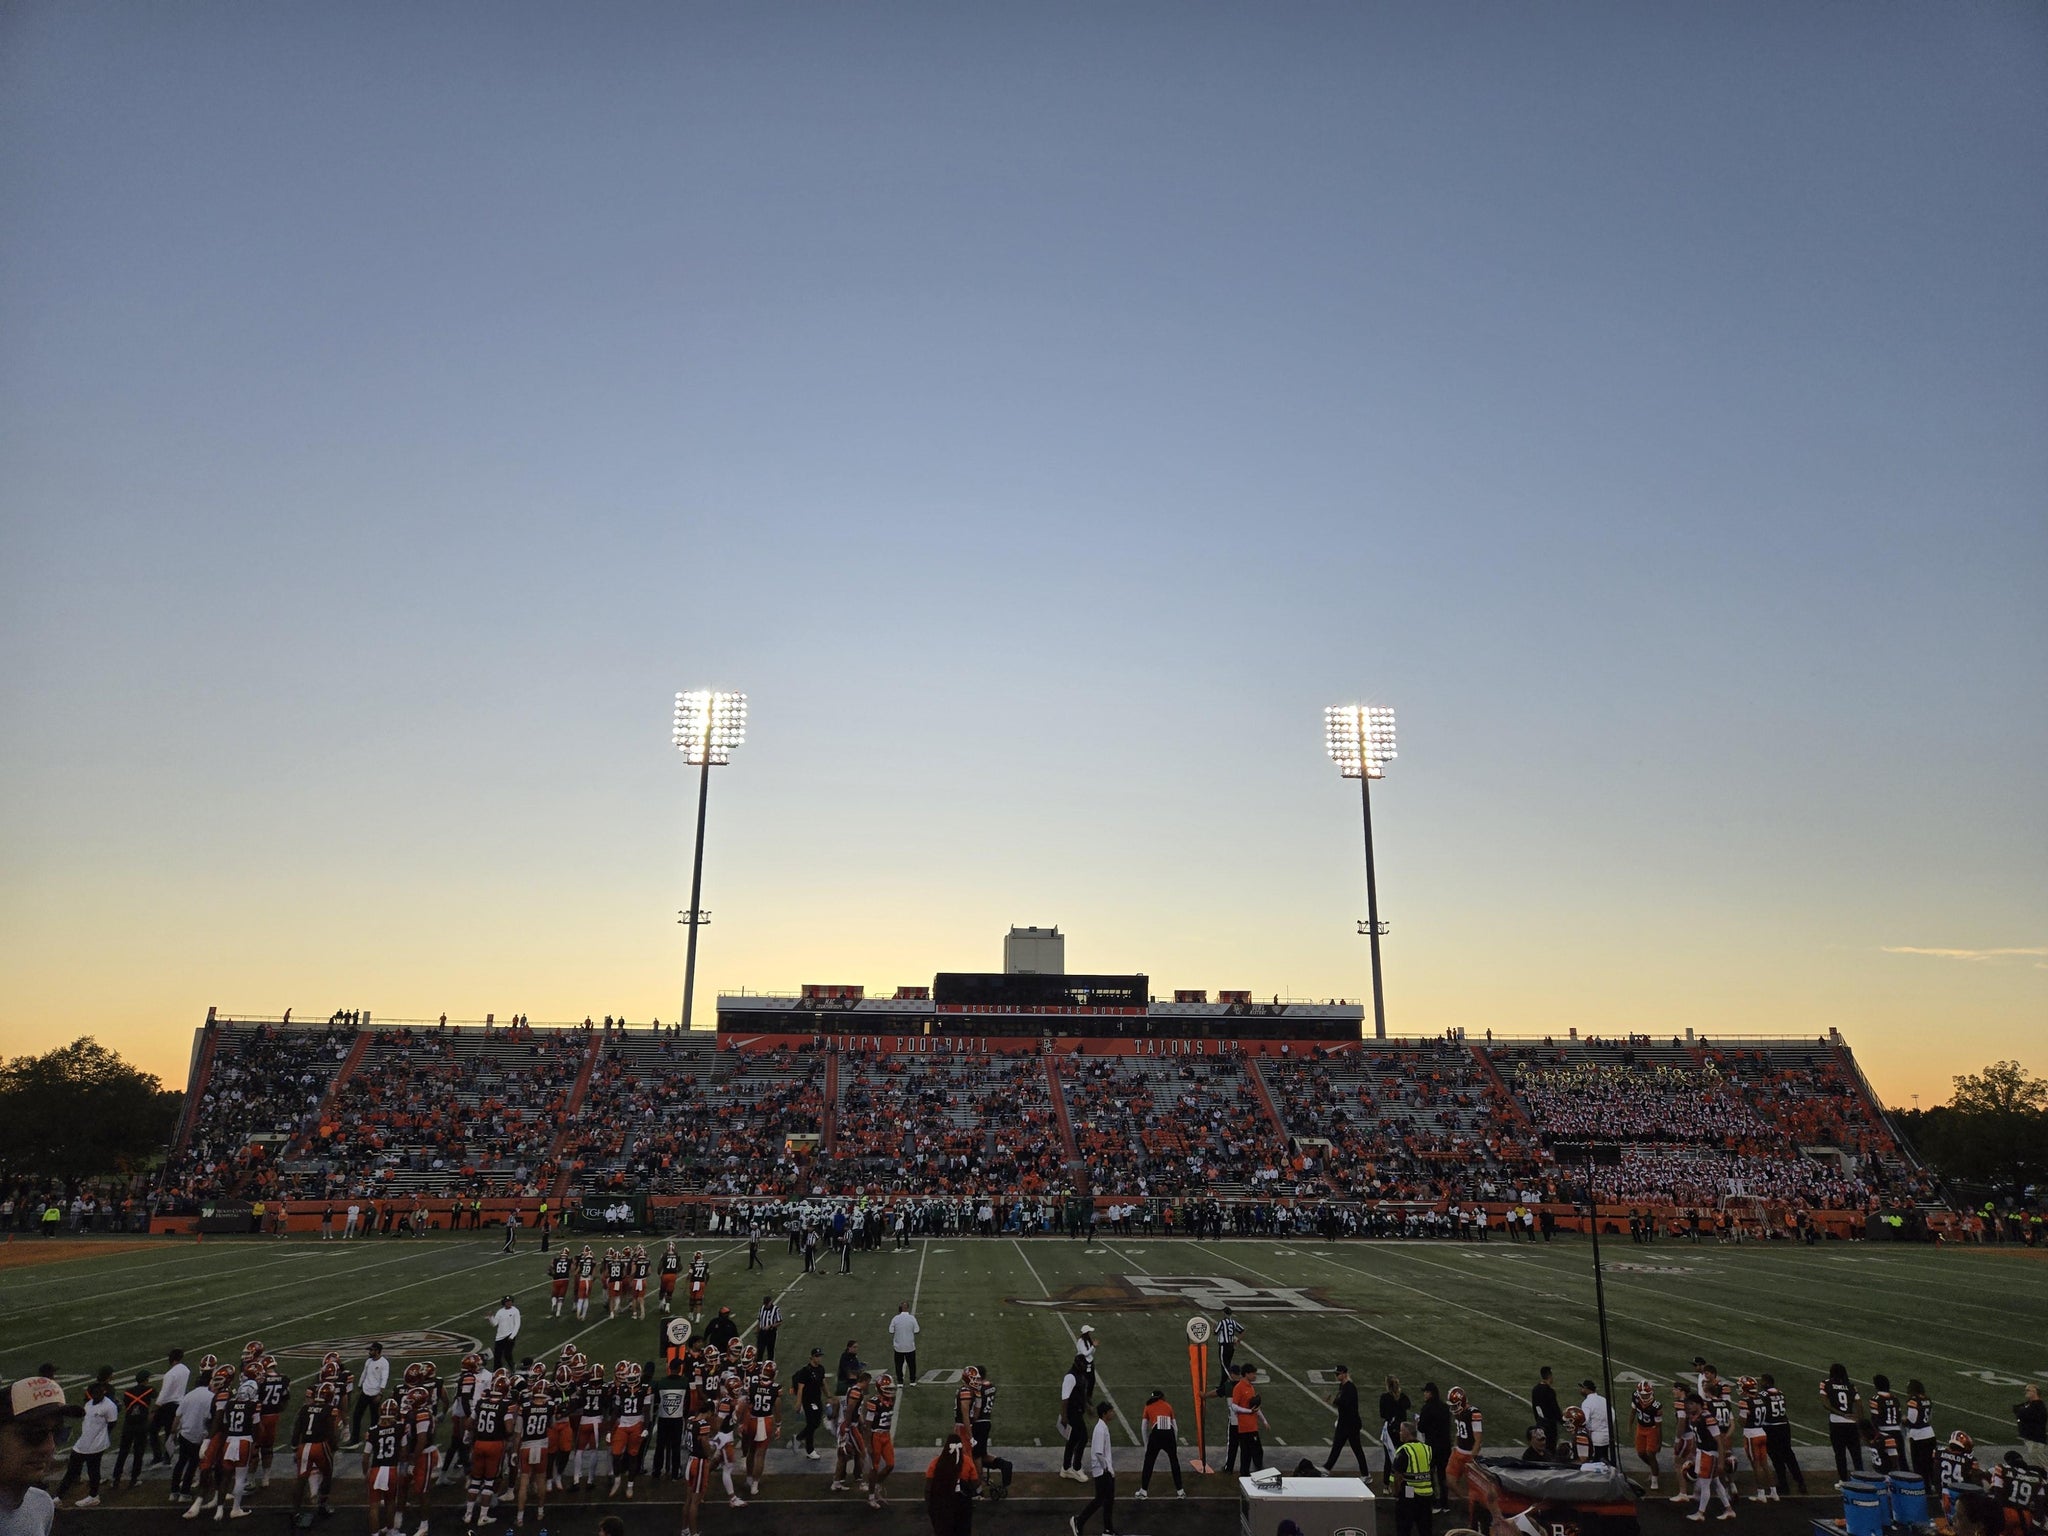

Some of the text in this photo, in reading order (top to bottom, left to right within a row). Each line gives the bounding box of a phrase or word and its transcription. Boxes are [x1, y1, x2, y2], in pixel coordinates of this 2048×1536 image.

[961, 1004, 1124, 1015] WELCOME TO THE DOYT
[813, 1036, 989, 1053] FALCON FOOTBALL
[1134, 1039, 1238, 1055] TALONS UP
[585, 1207, 606, 1217] TGH
[556, 1261, 568, 1274] 65
[1227, 1324, 1235, 1336] S
[262, 1384, 283, 1405] 75
[583, 1395, 600, 1411] 14
[754, 1394, 772, 1412] 85
[1837, 1391, 1848, 1412] 9
[623, 1397, 638, 1414] 21
[1770, 1401, 1787, 1417] 55
[228, 1410, 245, 1433] 12
[305, 1413, 315, 1435] 1
[477, 1409, 497, 1434] 66
[526, 1414, 548, 1436] 80
[1716, 1406, 1731, 1426] 40
[1754, 1405, 1768, 1426] 92
[1885, 1407, 1897, 1425] 11
[376, 1435, 396, 1460] 13
[1940, 1460, 1965, 1486] 24
[2008, 1479, 2033, 1507] 19
